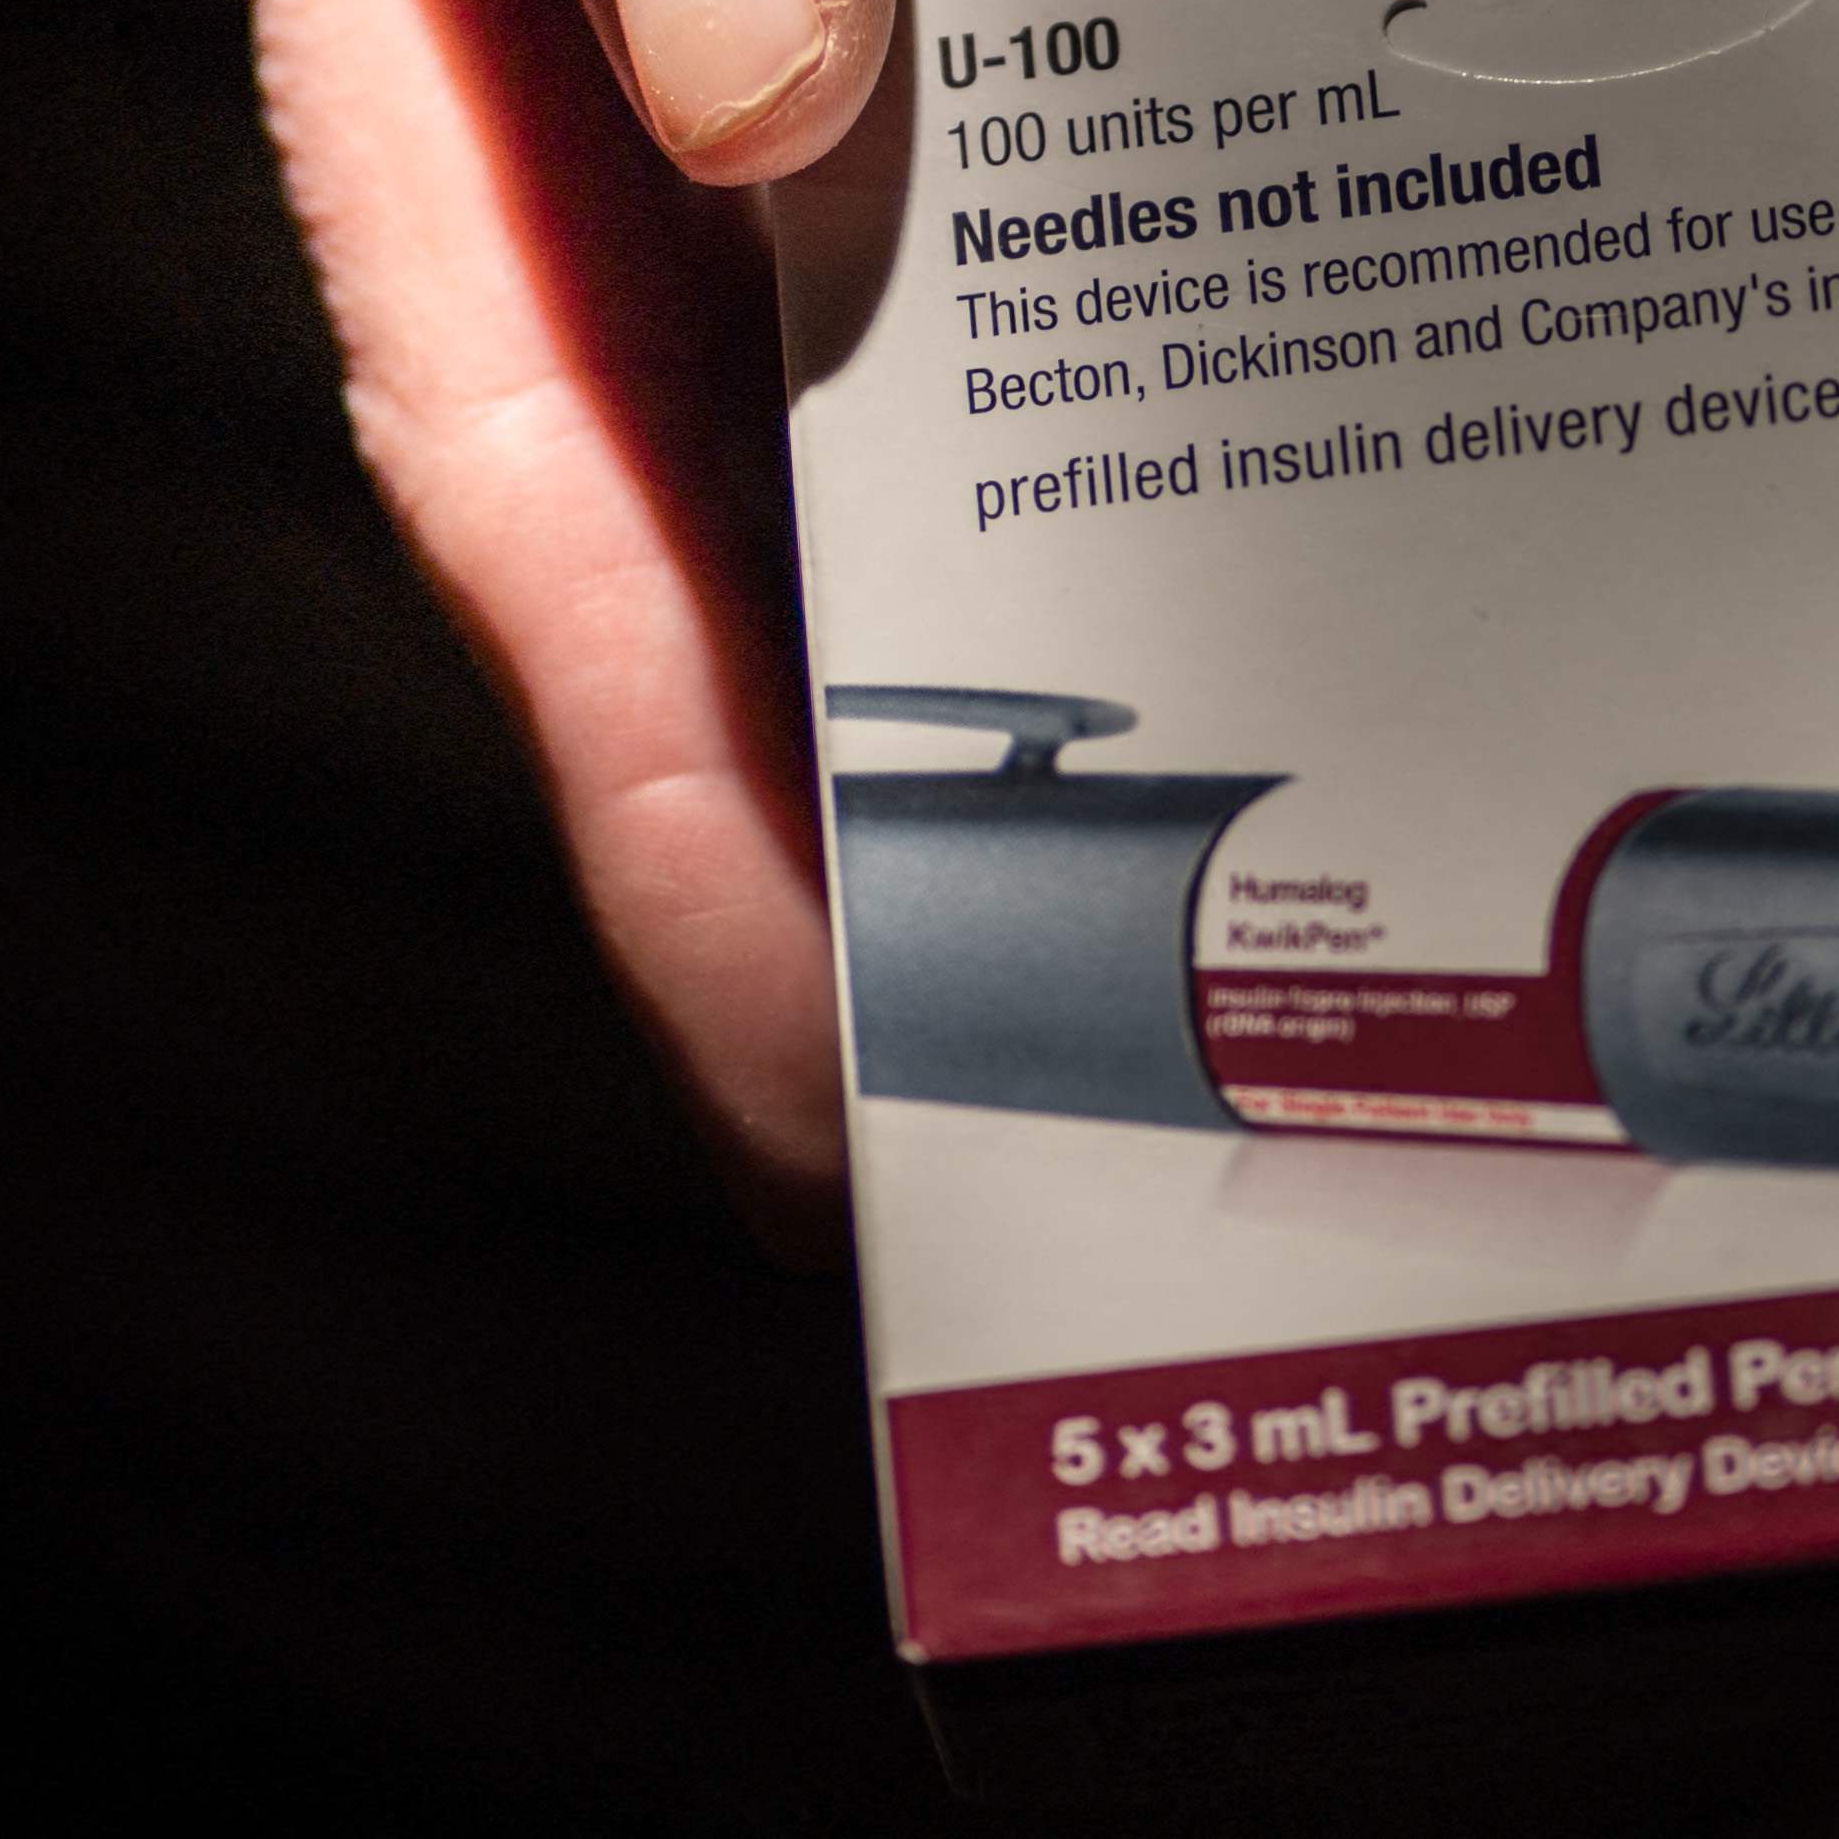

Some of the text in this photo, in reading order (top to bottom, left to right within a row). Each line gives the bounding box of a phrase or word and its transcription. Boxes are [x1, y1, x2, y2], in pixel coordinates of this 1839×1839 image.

[938, 16, 1121, 89] U-100
[948, 69, 1400, 169] 100 units per mL
[952, 134, 1602, 265] Needles not included
[956, 287, 1059, 340] This
[1075, 268, 1230, 326] device
[1247, 259, 1287, 305] is
[1303, 212, 1651, 299] recommended
[1666, 206, 1733, 254] for
[1751, 198, 1836, 243] use
[966, 358, 1146, 416] Becton,
[1162, 325, 1397, 390] Dickinson
[1414, 305, 1503, 360] and
[1520, 274, 1791, 346] Company's
[975, 444, 1199, 532] prefilled
[1221, 421, 1403, 490] insulin
[1425, 400, 1642, 464] delivery
[1229, 872, 1369, 912] Humalog
[1052, 1415, 1105, 1486] 5
[1117, 1423, 1170, 1480] x
[1181, 1400, 1237, 1471] 3
[1251, 1386, 1380, 1464] mL
[1390, 1344, 1715, 1448] Prefilled
[1057, 1493, 1221, 1566] Read
[1229, 1474, 1435, 1548] Insulin
[1441, 1452, 1693, 1523] Delivery
